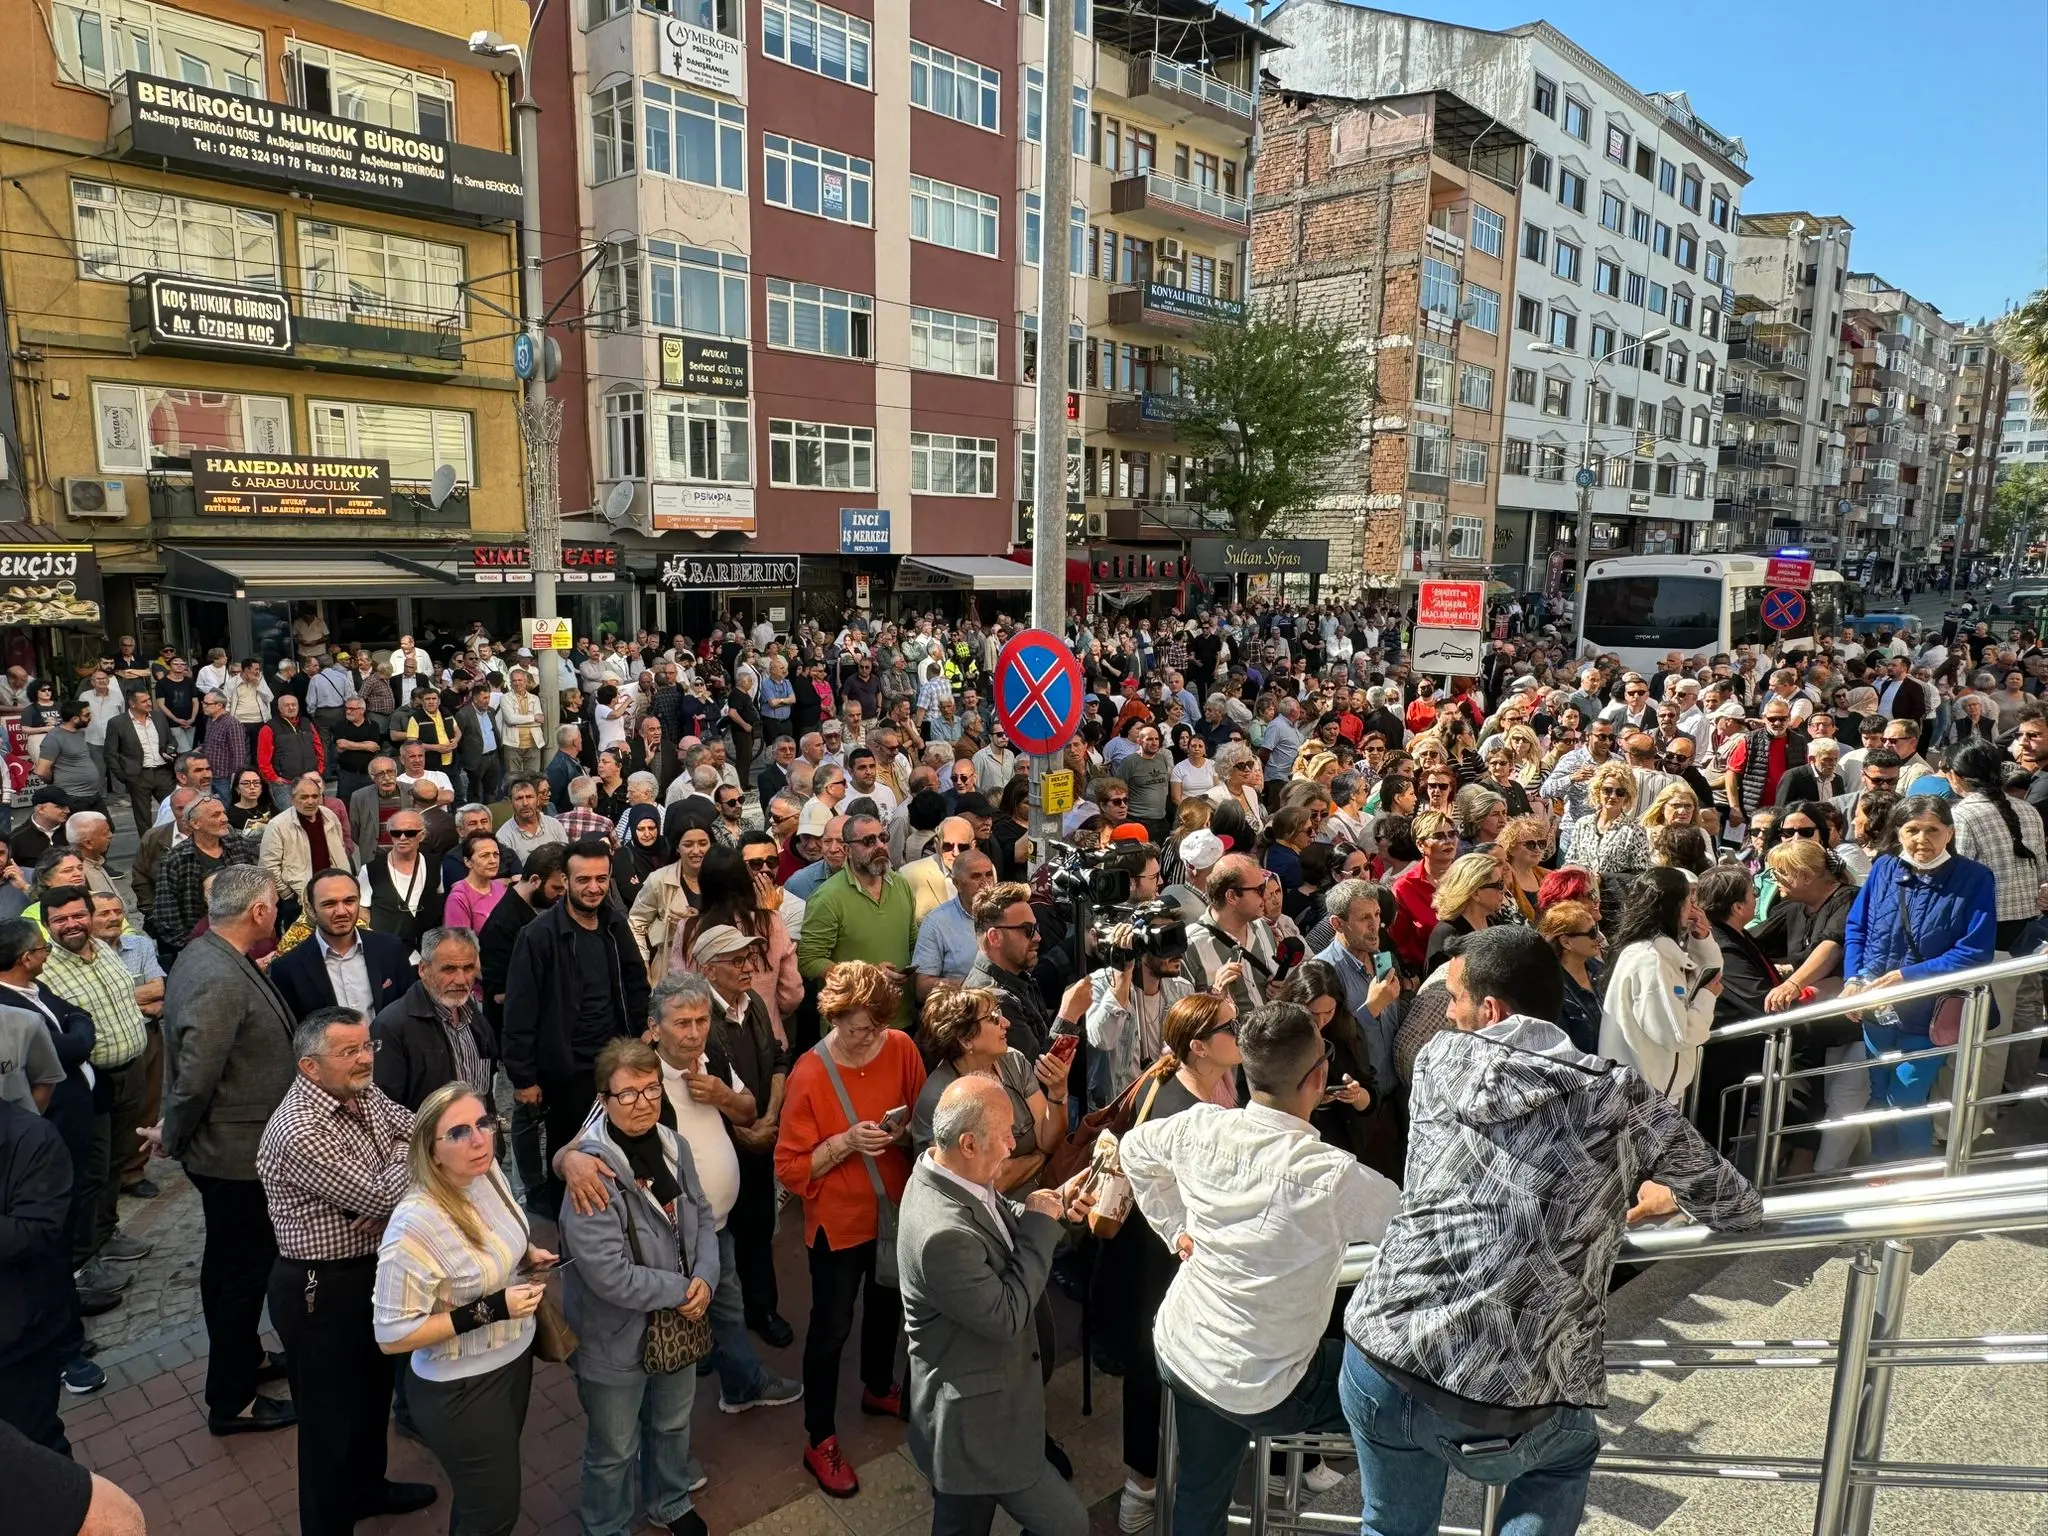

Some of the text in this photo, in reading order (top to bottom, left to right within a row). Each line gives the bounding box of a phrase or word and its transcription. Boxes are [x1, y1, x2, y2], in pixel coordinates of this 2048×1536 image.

[137, 82, 444, 164] BEKİROĞLU HUKUK BÜROSU
[182, 116, 234, 137] BEKİROĞLU
[236, 127, 261, 143] KÖSE
[193, 137, 211, 153] Tel
[219, 142, 227, 155] 0
[229, 144, 249, 160] 262
[251, 148, 270, 164] 324
[273, 151, 285, 167] 91
[288, 154, 301, 169] 78
[306, 143, 352, 161] BEKİROĞLU
[305, 159, 324, 175] Fax
[330, 165, 338, 176] 0
[339, 166, 358, 181] 262
[359, 170, 377, 184] 324
[378, 172, 390, 187] 91
[392, 175, 404, 189] 79
[1151, 284, 1186, 301] KONYALI
[161, 289, 281, 321] KOÇ HUKUK BÜROSU
[199, 315, 245, 340] ÖZDEN
[247, 323, 275, 345] KOÇ
[701, 348, 728, 360] AVUKAT
[206, 458, 379, 479] HANEDAN HUKUK
[231, 476, 360, 492] & ARABULUCULUK
[852, 511, 879, 526] İNCİ
[843, 528, 889, 546] İŞ MERKEZİ
[564, 548, 616, 566] CAFE
[1224, 544, 1301, 570] Sultan Sofrası
